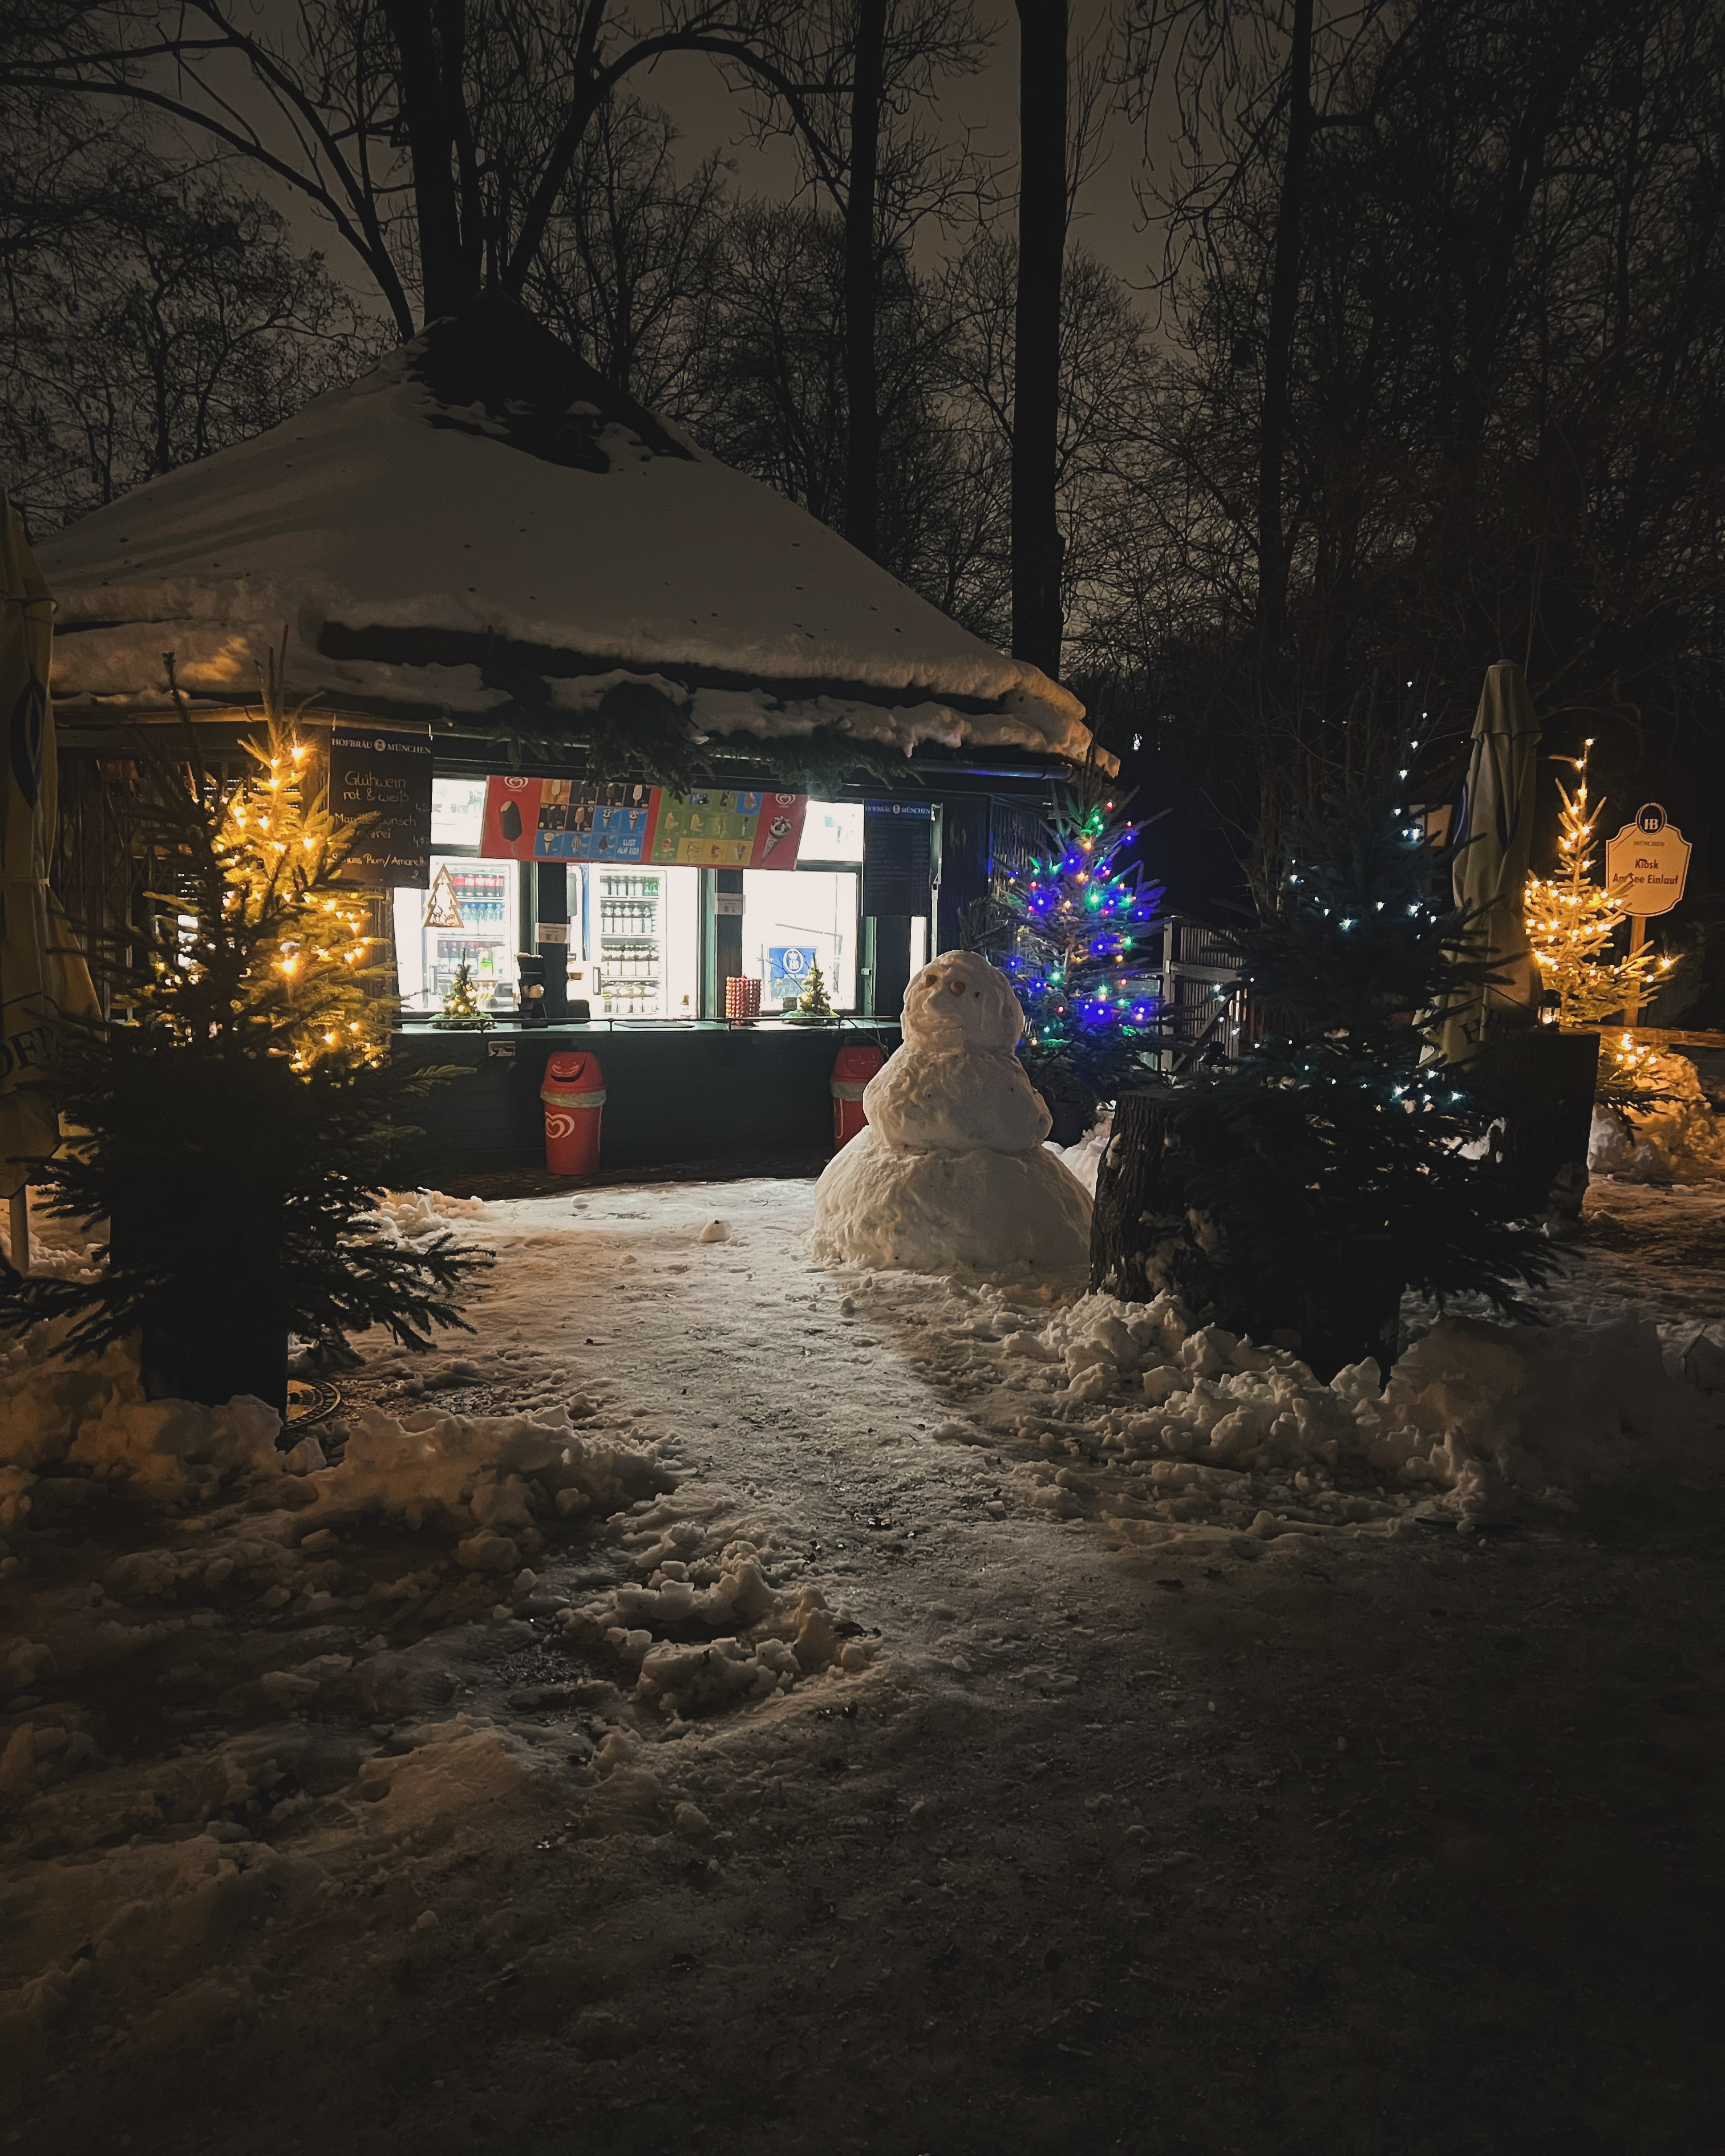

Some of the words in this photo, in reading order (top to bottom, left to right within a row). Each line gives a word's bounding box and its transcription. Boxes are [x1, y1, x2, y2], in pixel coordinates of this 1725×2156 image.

[332, 738, 372, 749] HOFBRÄU
[387, 743, 431, 753] MÜNCHEN
[345, 771, 406, 788] Glühwein
[343, 788, 361, 800] rot
[366, 788, 375, 801] &
[901, 806, 930, 814] MÜNCHEN
[1645, 818, 1658, 830] HB
[1635, 858, 1659, 869] Kiosk
[1647, 874, 1679, 885] Einlauf
